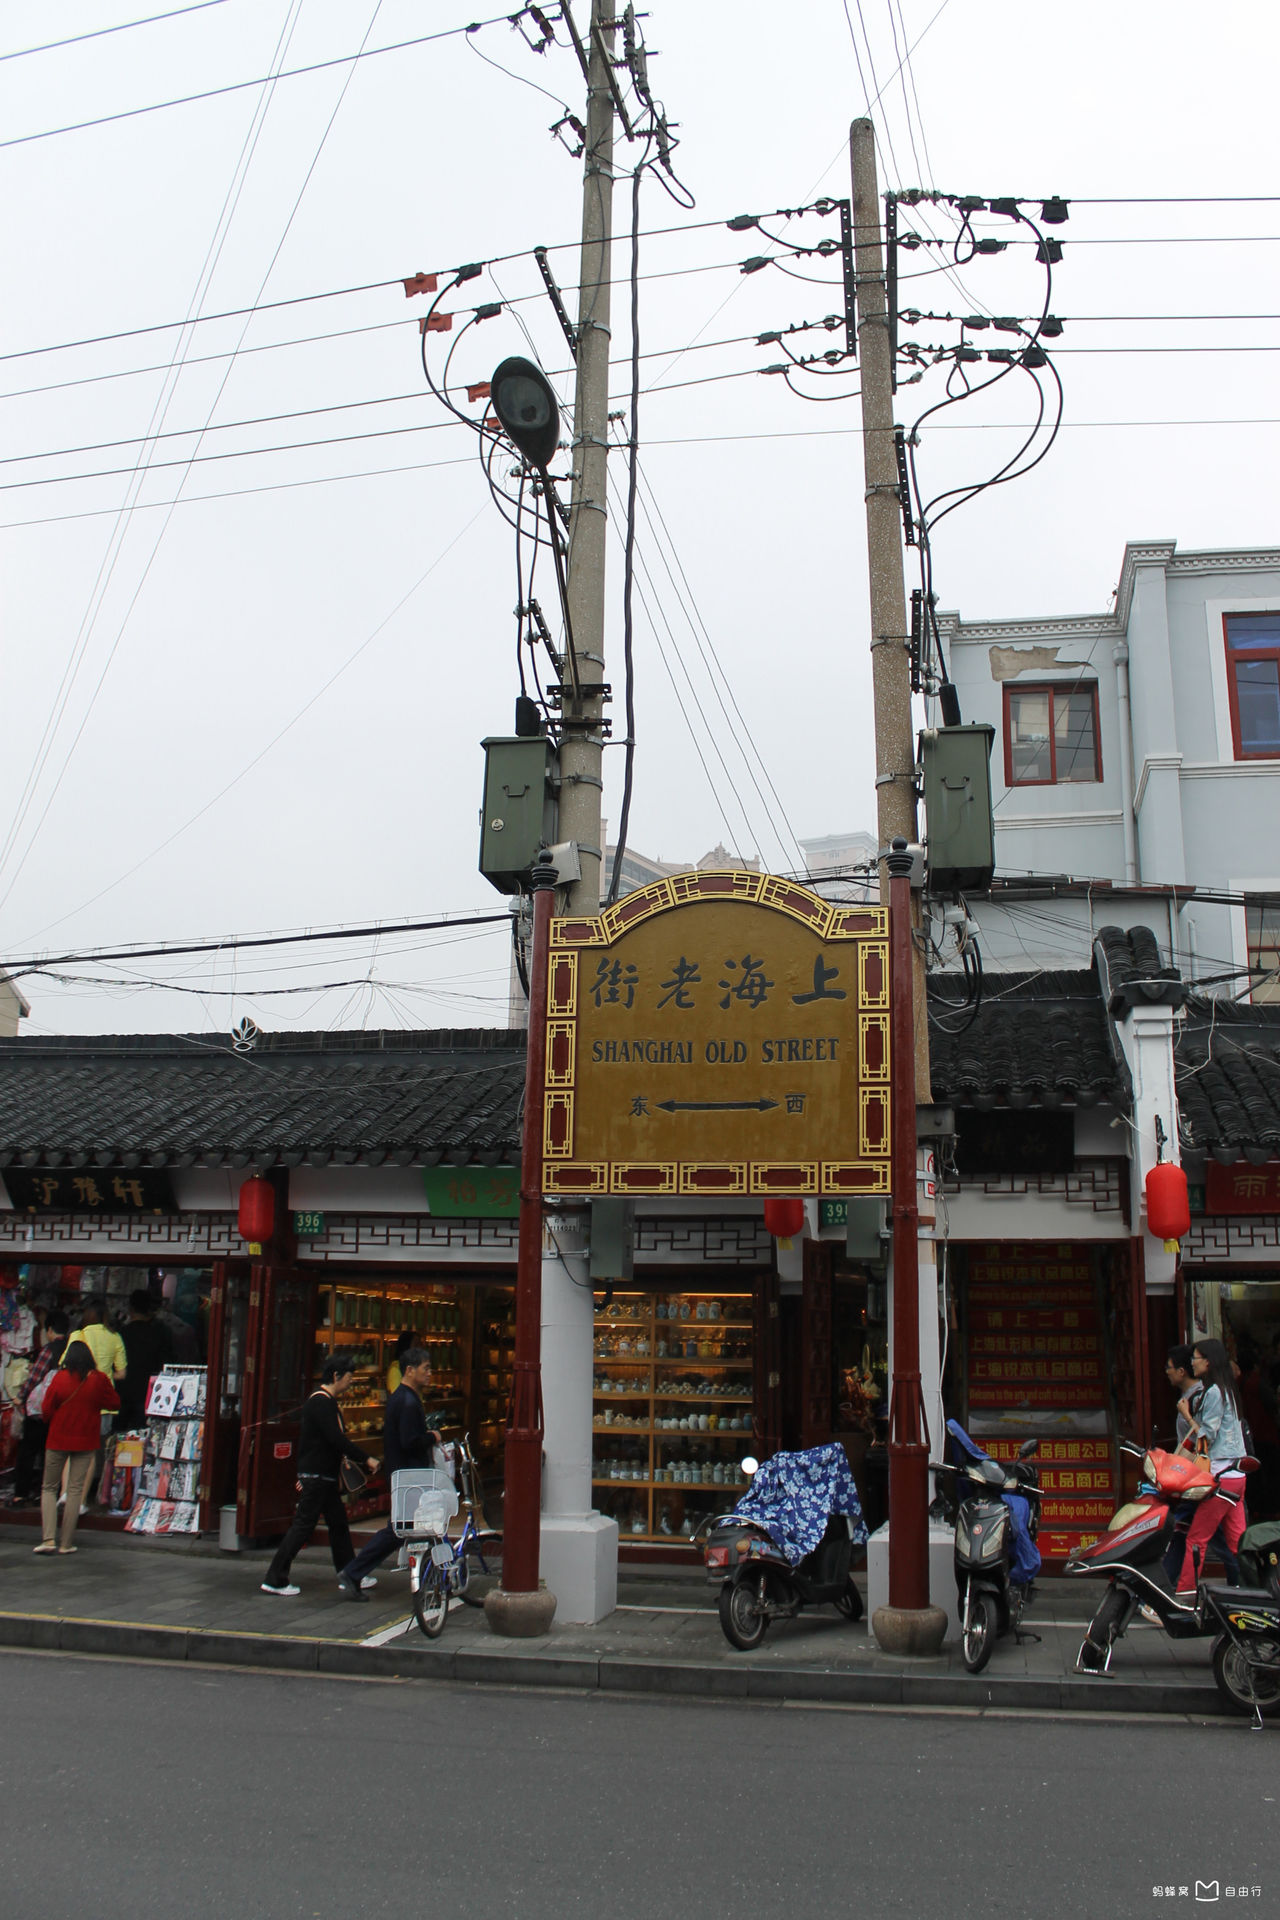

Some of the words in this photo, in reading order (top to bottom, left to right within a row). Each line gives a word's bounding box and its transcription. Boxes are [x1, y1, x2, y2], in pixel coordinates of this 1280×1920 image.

[592, 1040, 693, 1064] SHANGHAI
[705, 1040, 747, 1064] OLD
[762, 1038, 840, 1063] STREET
[628, 1095, 651, 1117] 东
[784, 1094, 807, 1115] 西
[1233, 1175, 1280, 1199] 雨
[296, 1214, 320, 1227] 396
[1038, 1472, 1110, 1489] 礼品商店
[1059, 1503, 1075, 1519] shop
[1076, 1506, 1085, 1516] on
[1086, 1503, 1098, 1516] 2nd
